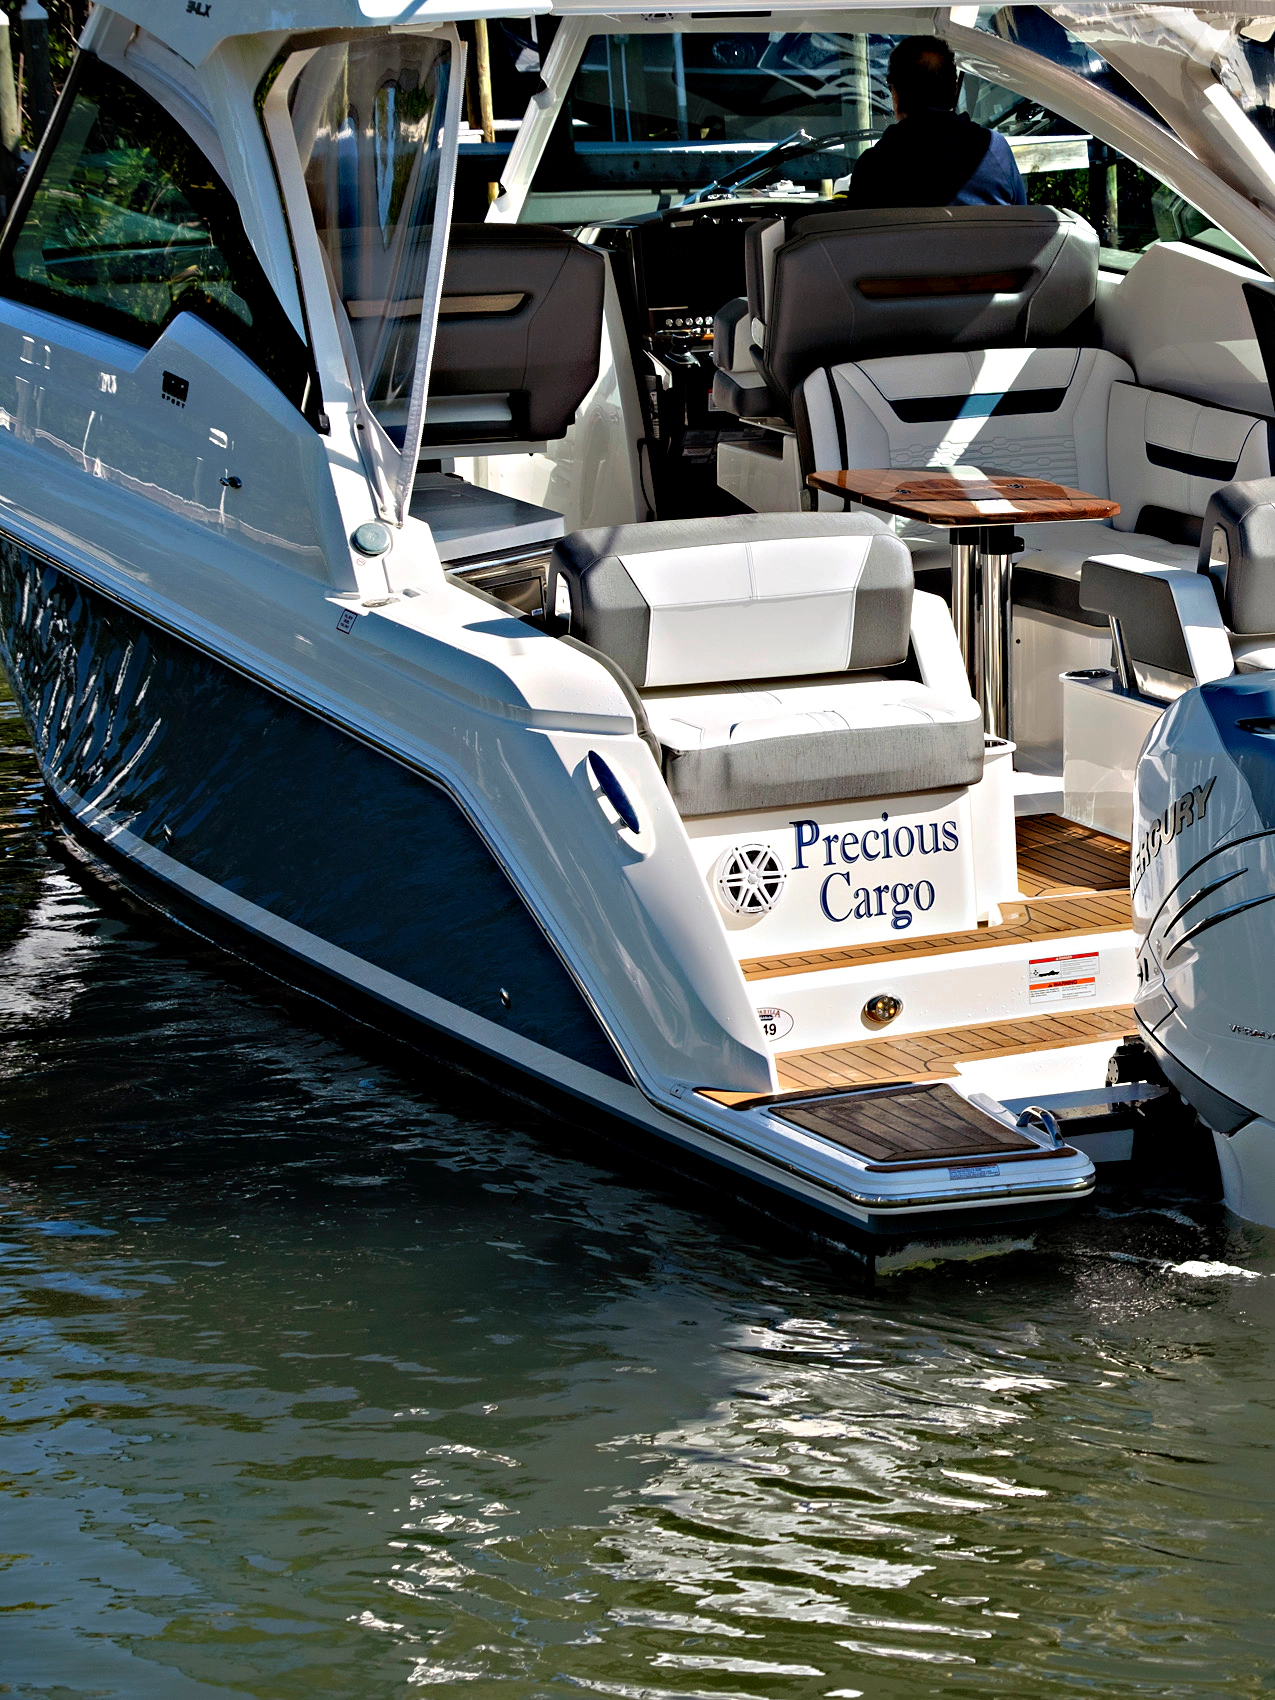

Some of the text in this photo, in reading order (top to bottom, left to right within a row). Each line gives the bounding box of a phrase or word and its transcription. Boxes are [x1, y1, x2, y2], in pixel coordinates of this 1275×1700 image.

[788, 811, 960, 871] Precious
[1131, 775, 1218, 900] ERCURY
[819, 871, 936, 931] Cargo
